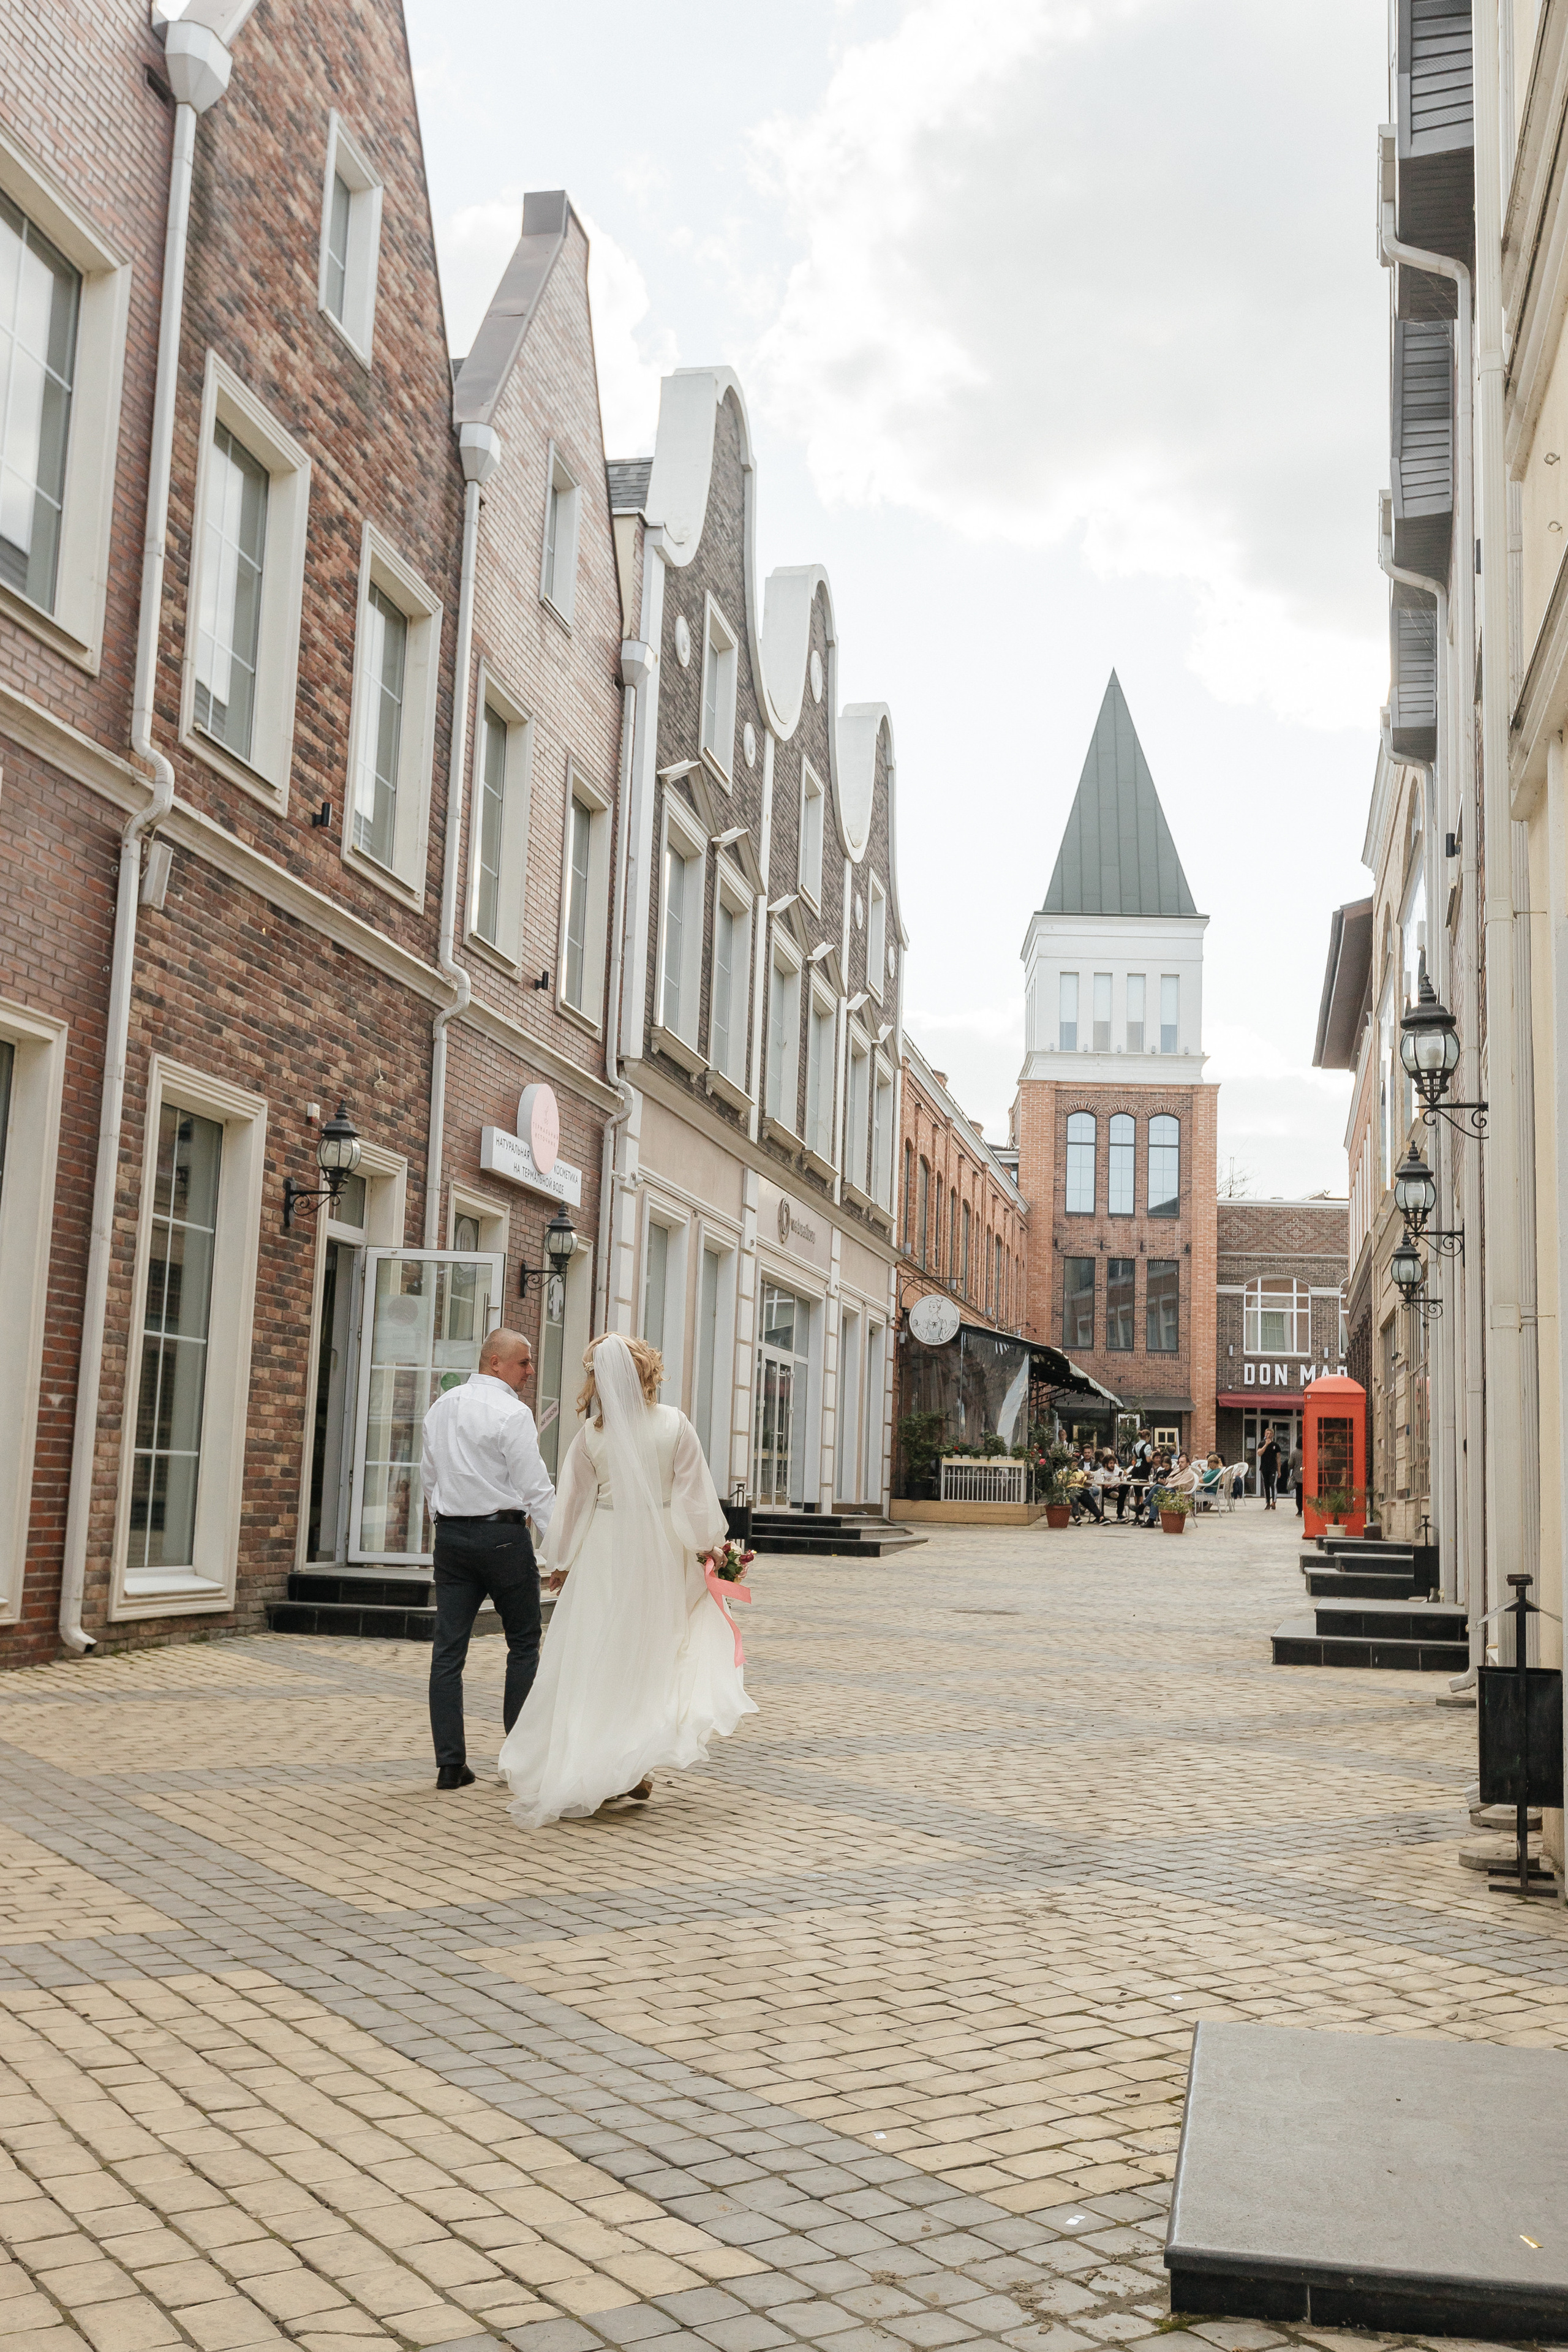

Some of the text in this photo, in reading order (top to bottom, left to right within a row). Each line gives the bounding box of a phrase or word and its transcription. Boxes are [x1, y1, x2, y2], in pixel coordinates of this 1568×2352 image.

[496, 1135, 578, 1185] НАТУРАЛЬНАЯ КОСМЕТИКА
[513, 1162, 564, 1195] НА ТЕРМАЛЬНОЙ ВОДЕ
[1243, 1363, 1288, 1385] DON
